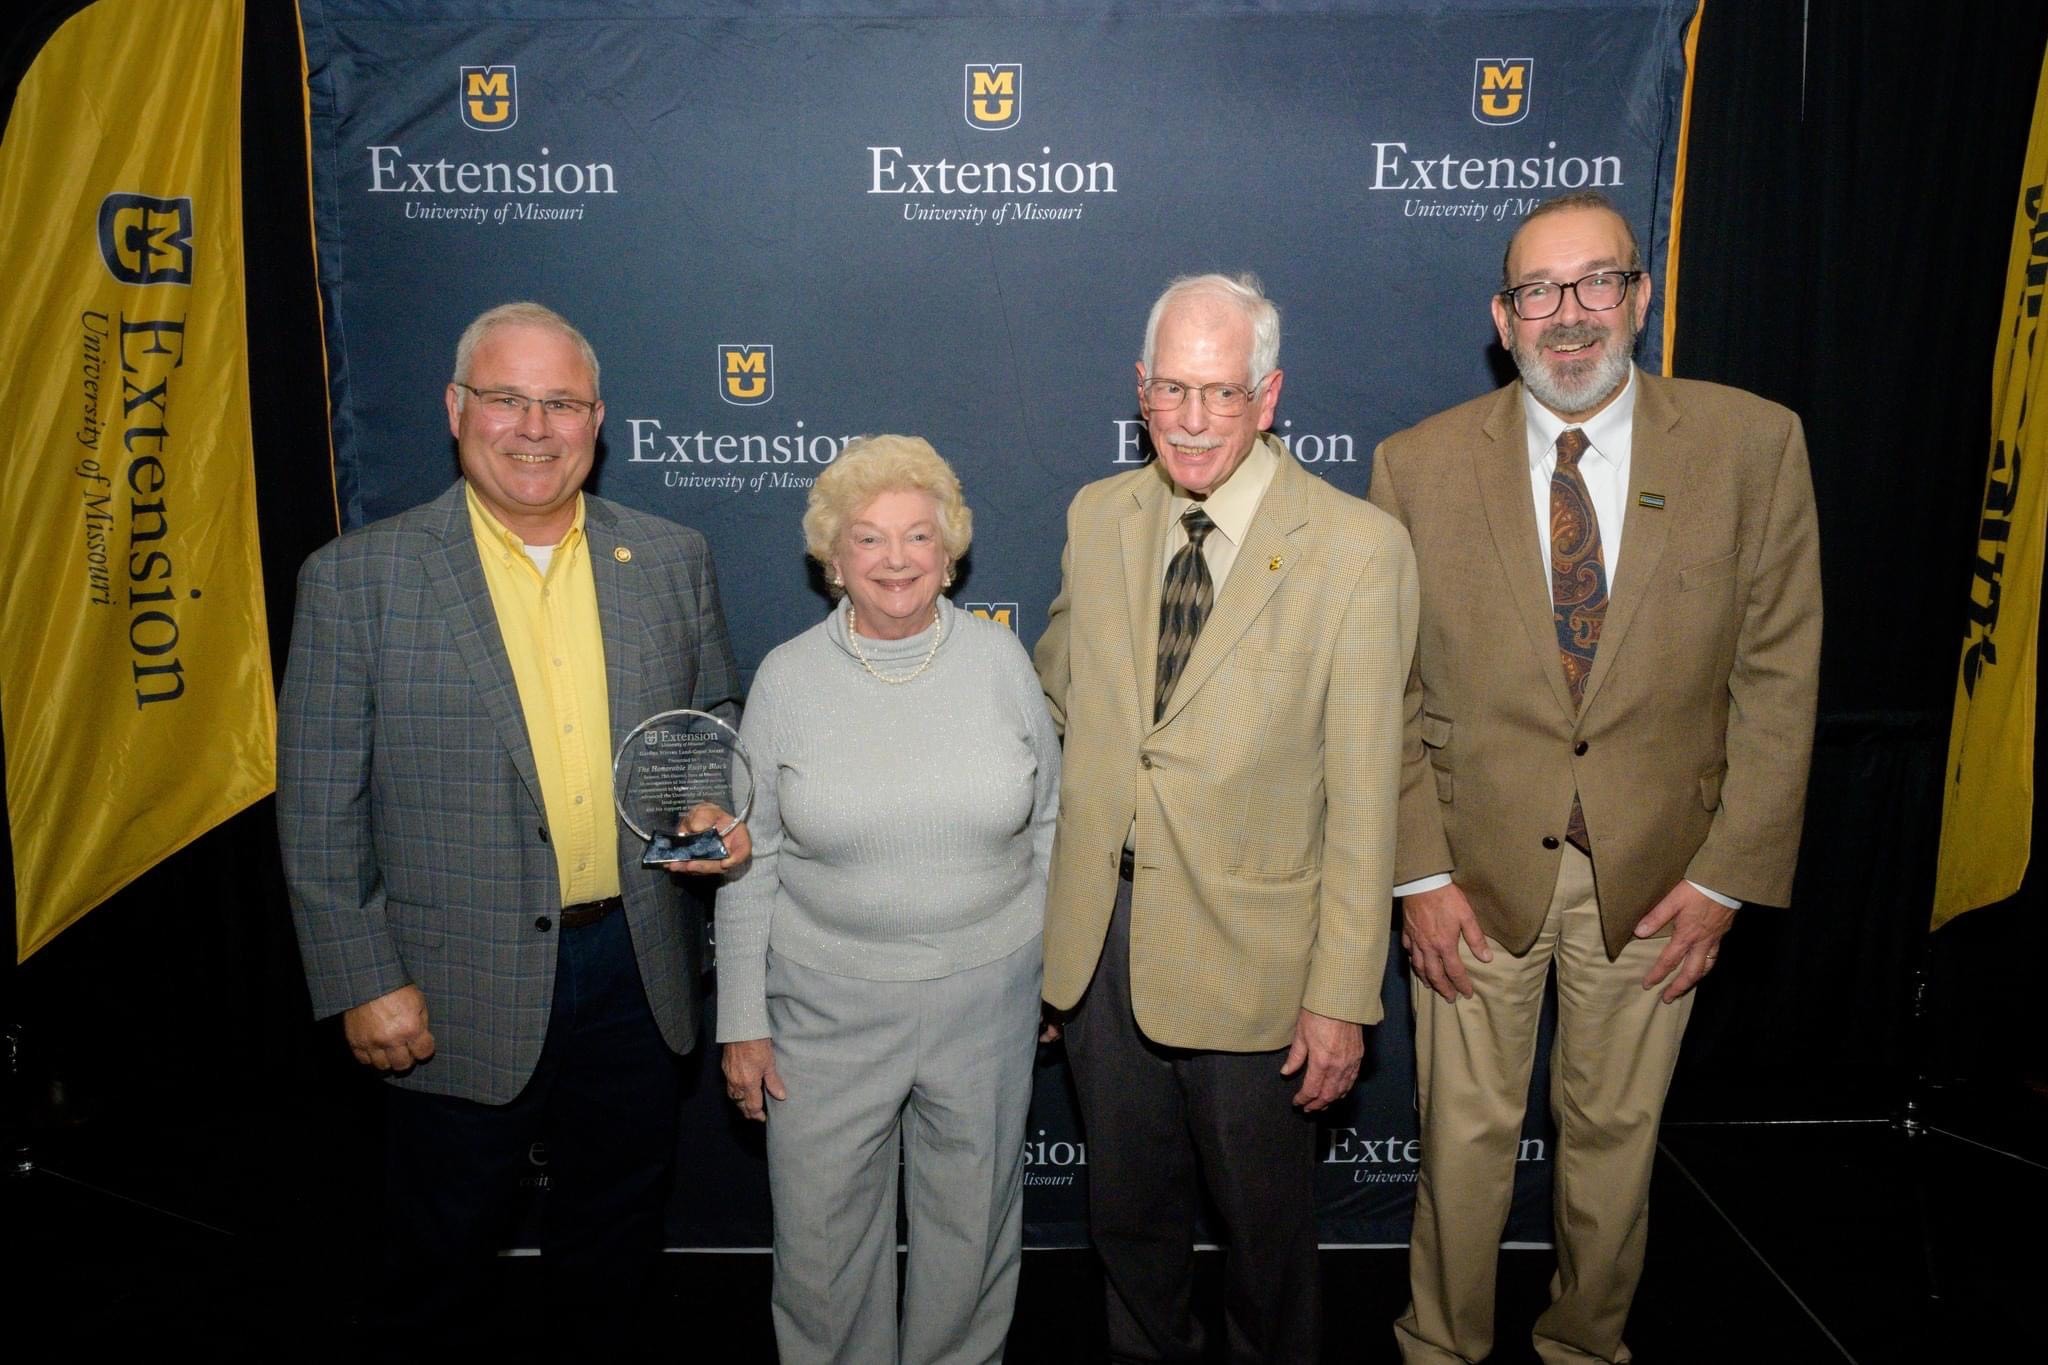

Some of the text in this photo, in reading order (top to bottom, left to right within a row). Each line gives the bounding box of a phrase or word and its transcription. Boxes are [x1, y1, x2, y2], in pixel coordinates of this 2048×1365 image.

[366, 145, 619, 195] Extension
[866, 146, 1118, 194] Extension
[1368, 141, 1624, 190] Extension
[404, 201, 585, 225] University of Missouri
[903, 202, 1083, 226] University of Missouri
[1404, 199, 1488, 222] University
[1493, 199, 1513, 222] of
[75, 311, 117, 606] University of Missouri
[664, 471, 816, 493] University of Misso
[119, 311, 202, 711] Extension
[660, 731, 719, 742] Extension
[1024, 1171, 1074, 1186] issouri
